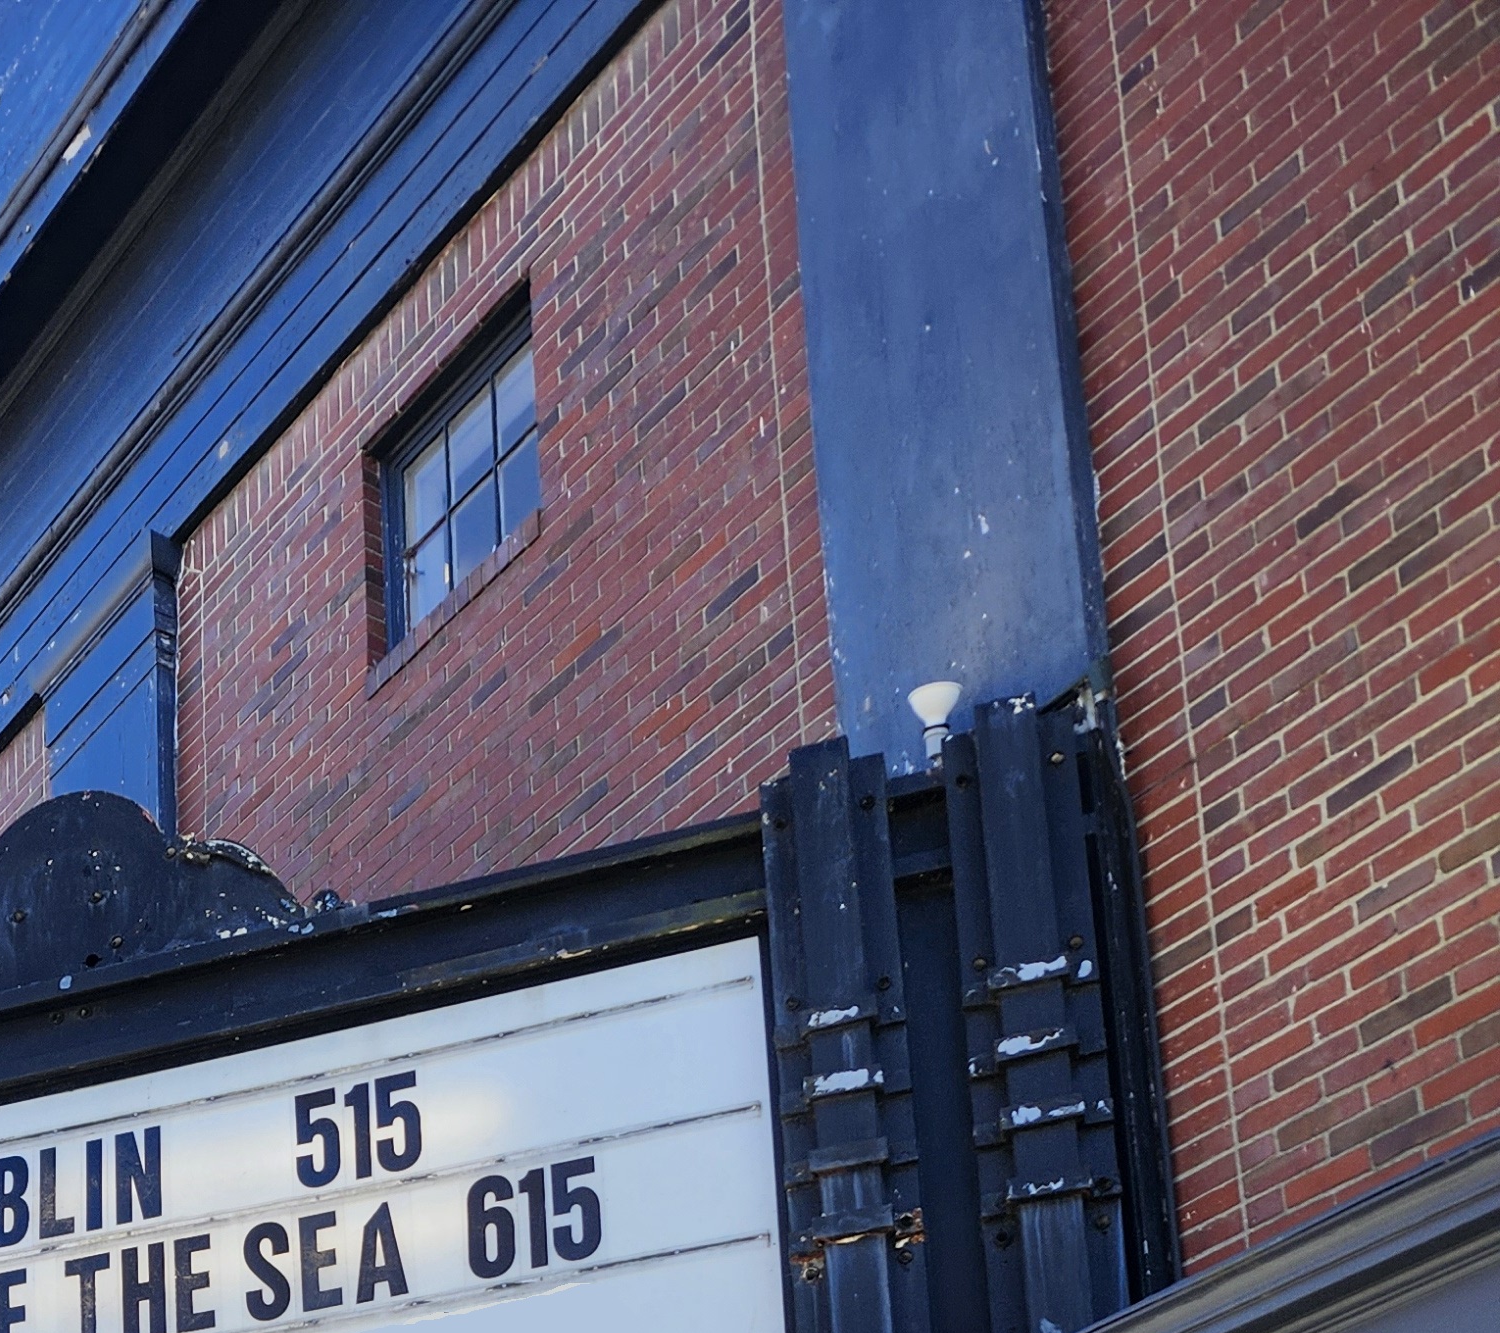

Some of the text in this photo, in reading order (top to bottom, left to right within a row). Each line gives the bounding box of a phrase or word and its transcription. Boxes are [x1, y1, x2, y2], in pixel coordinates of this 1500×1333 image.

[294, 1070, 422, 1188] 515
[243, 1201, 409, 1321] SEA
[467, 1156, 602, 1279] 615
